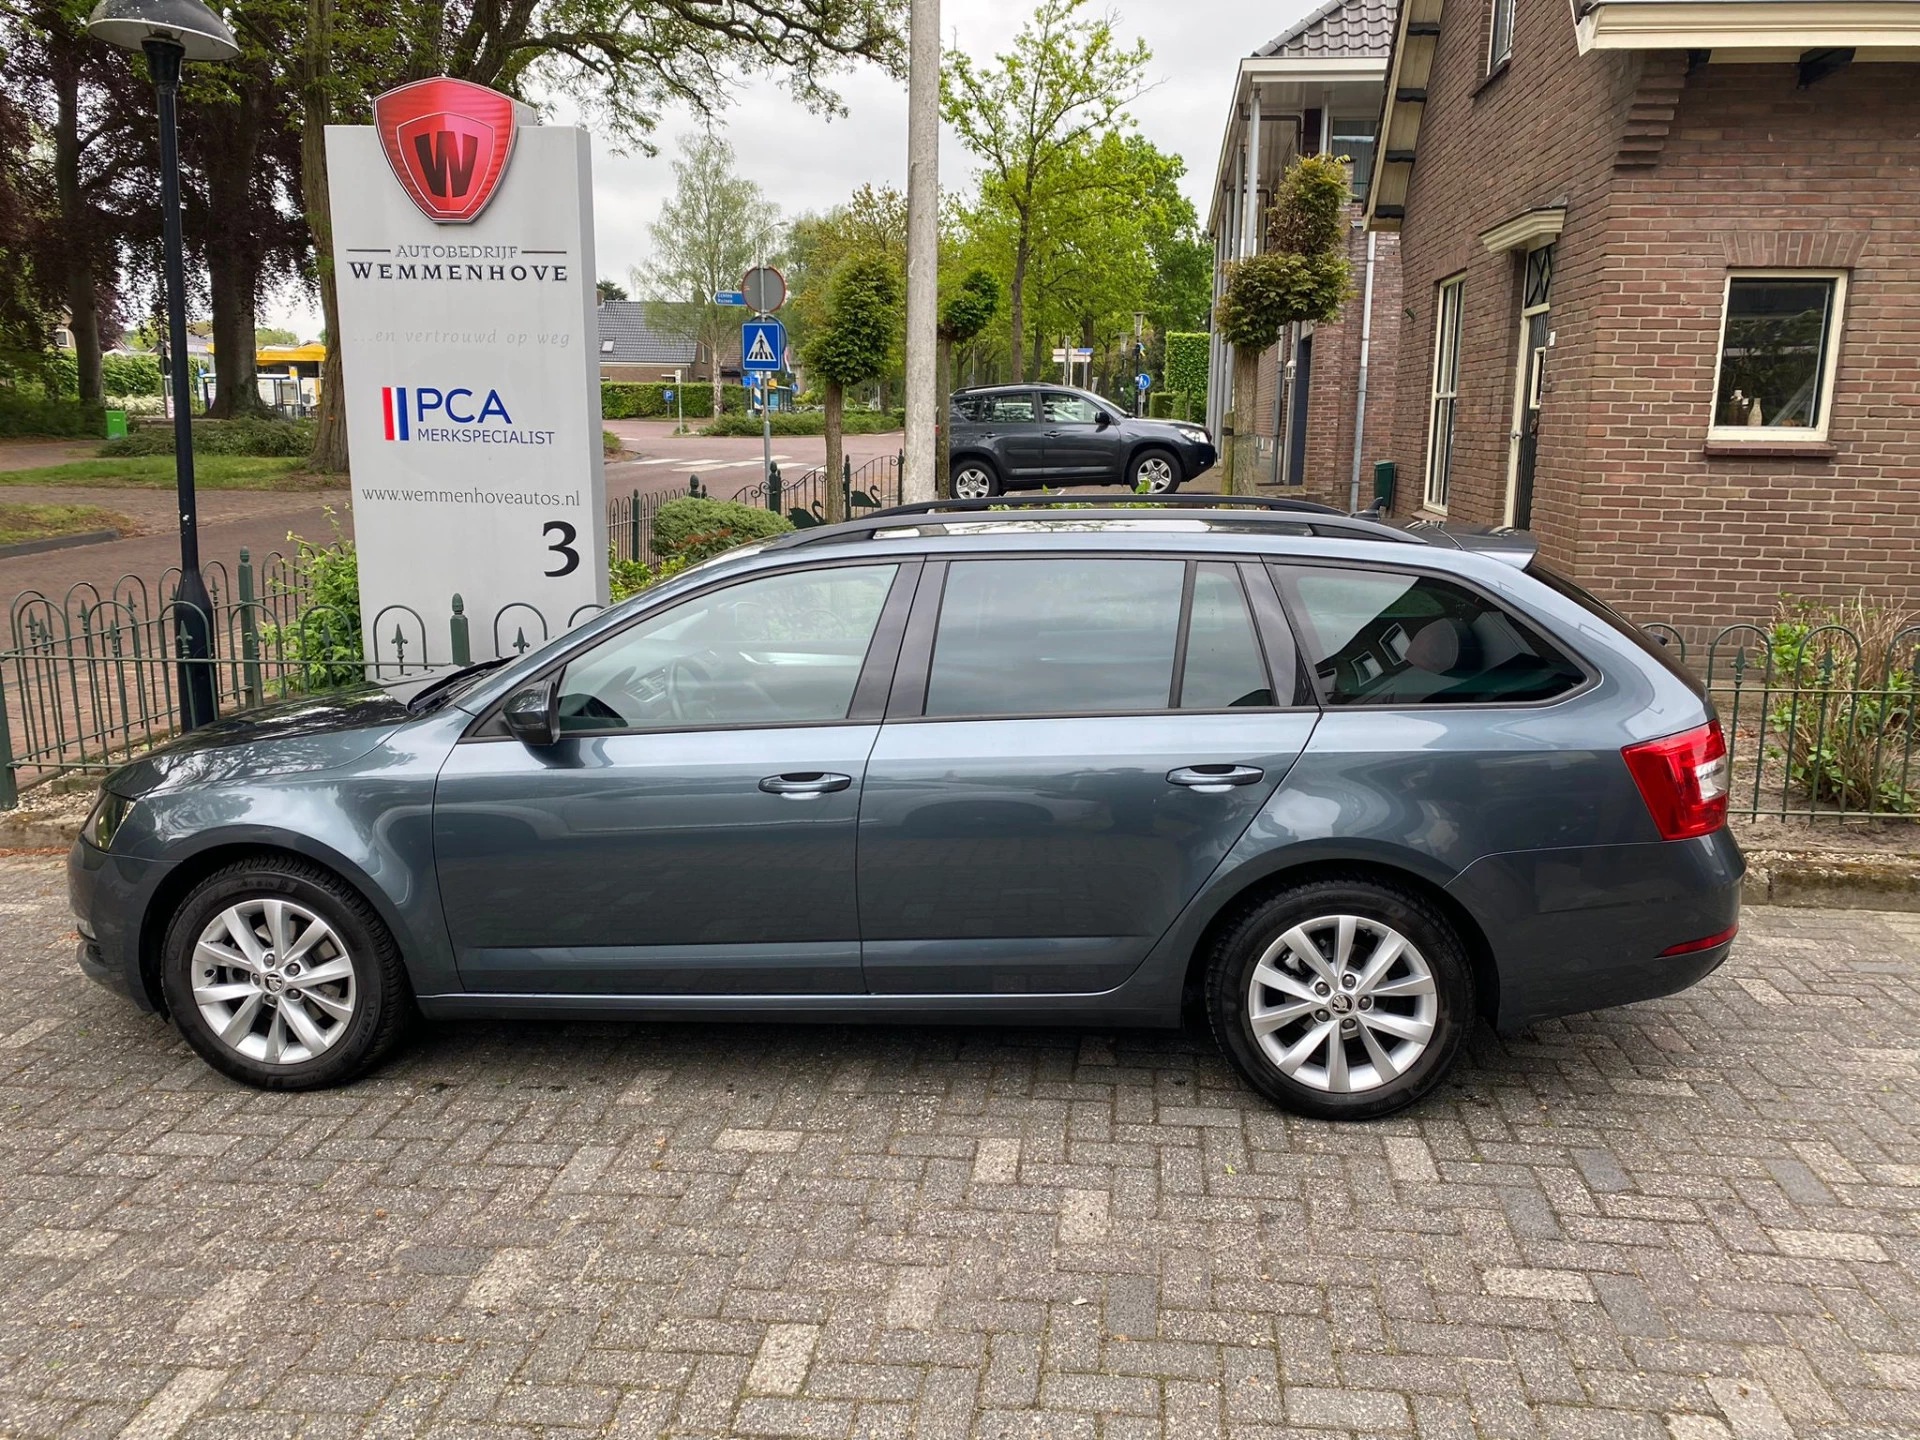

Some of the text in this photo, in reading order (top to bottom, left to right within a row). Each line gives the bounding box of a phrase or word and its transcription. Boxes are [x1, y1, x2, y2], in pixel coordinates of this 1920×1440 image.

[414, 130, 478, 198] W
[395, 245, 518, 259] AUTOBEDRIJF
[347, 261, 567, 281] WEMMENHOVE
[405, 329, 497, 344] vertrouwd
[506, 333, 528, 346] op
[537, 333, 570, 348] weg
[416, 388, 513, 424] PCA
[417, 428, 555, 444] MERKSPECIALIST
[361, 487, 580, 507] www.wemmenhoveautos.nl
[542, 520, 581, 578] 3
